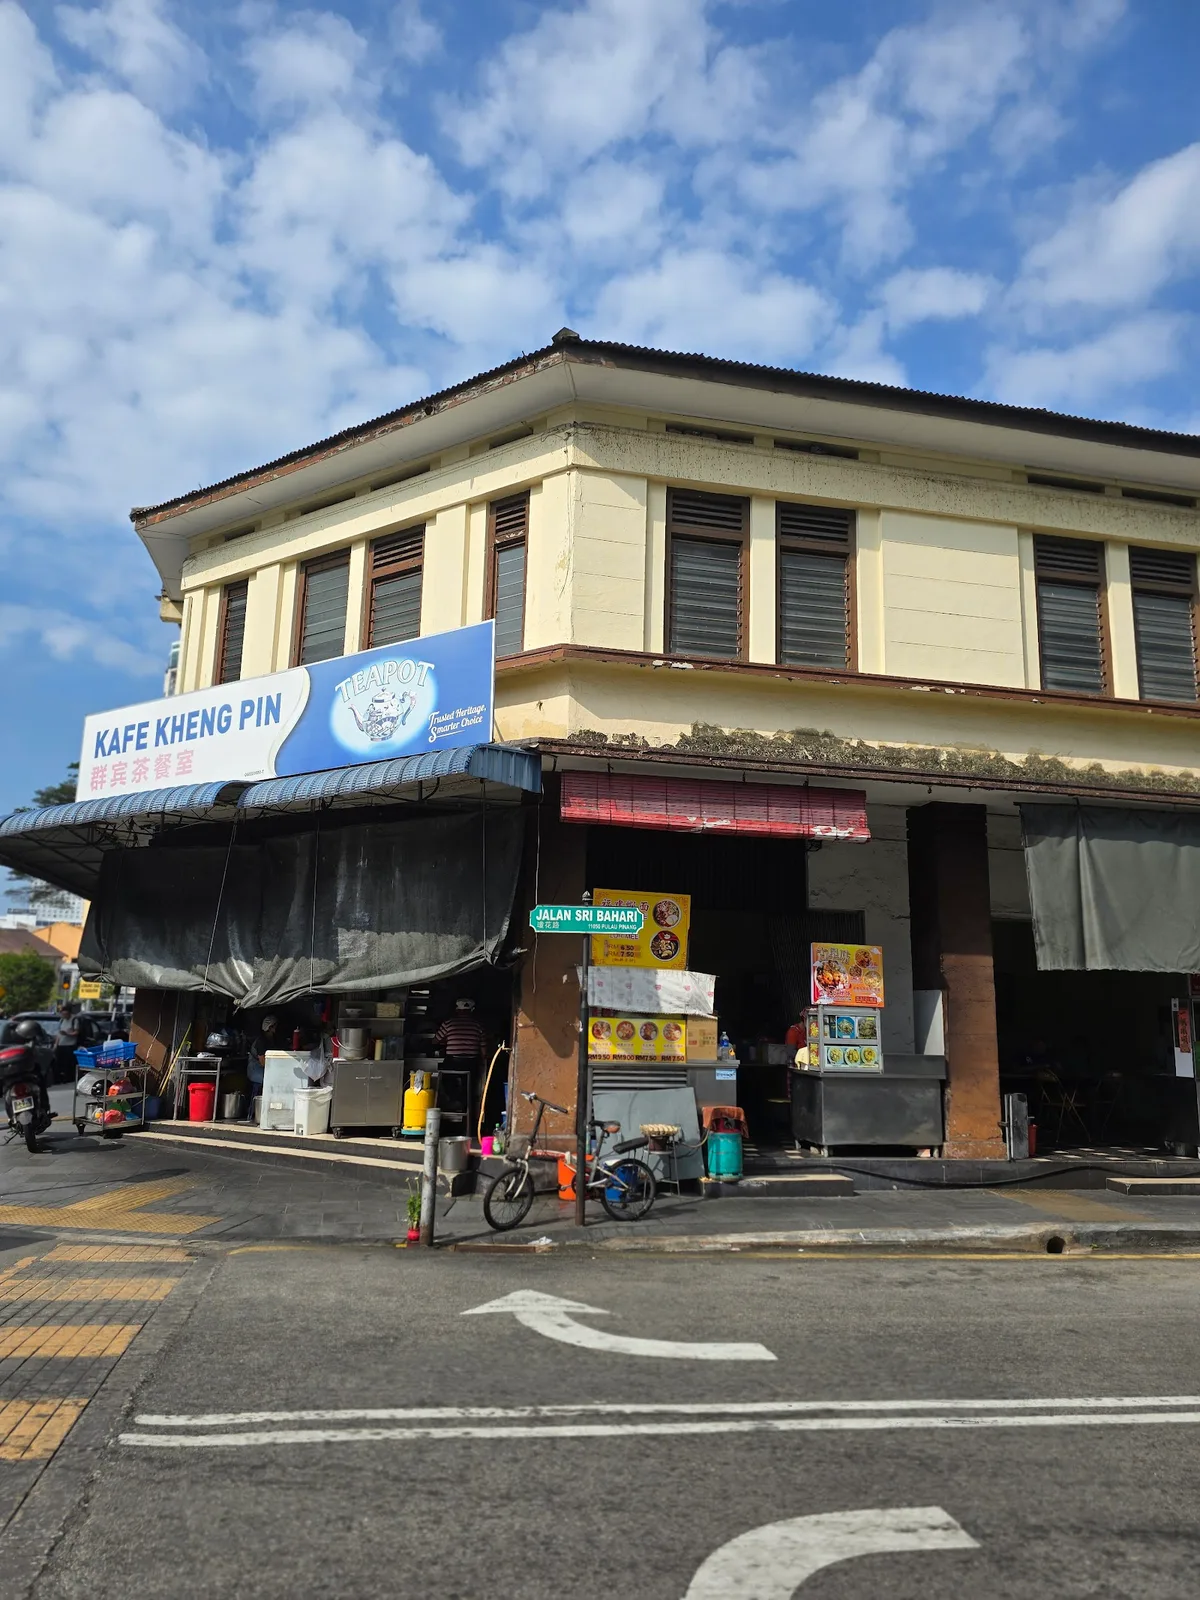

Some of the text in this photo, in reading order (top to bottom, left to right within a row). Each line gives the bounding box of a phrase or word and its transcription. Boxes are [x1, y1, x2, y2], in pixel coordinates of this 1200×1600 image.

[335, 659, 435, 703] TEAPOT
[94, 693, 282, 759] KAFE KHENG PIN
[428, 704, 487, 730] Trusted Heritage,
[428, 715, 483, 743] Smarter Choice
[90, 749, 194, 792] 群宾茶餐室
[536, 909, 571, 921] JALAN
[575, 910, 593, 922] SRI
[596, 910, 638, 923] BAHARI
[601, 923, 618, 931] PULAU
